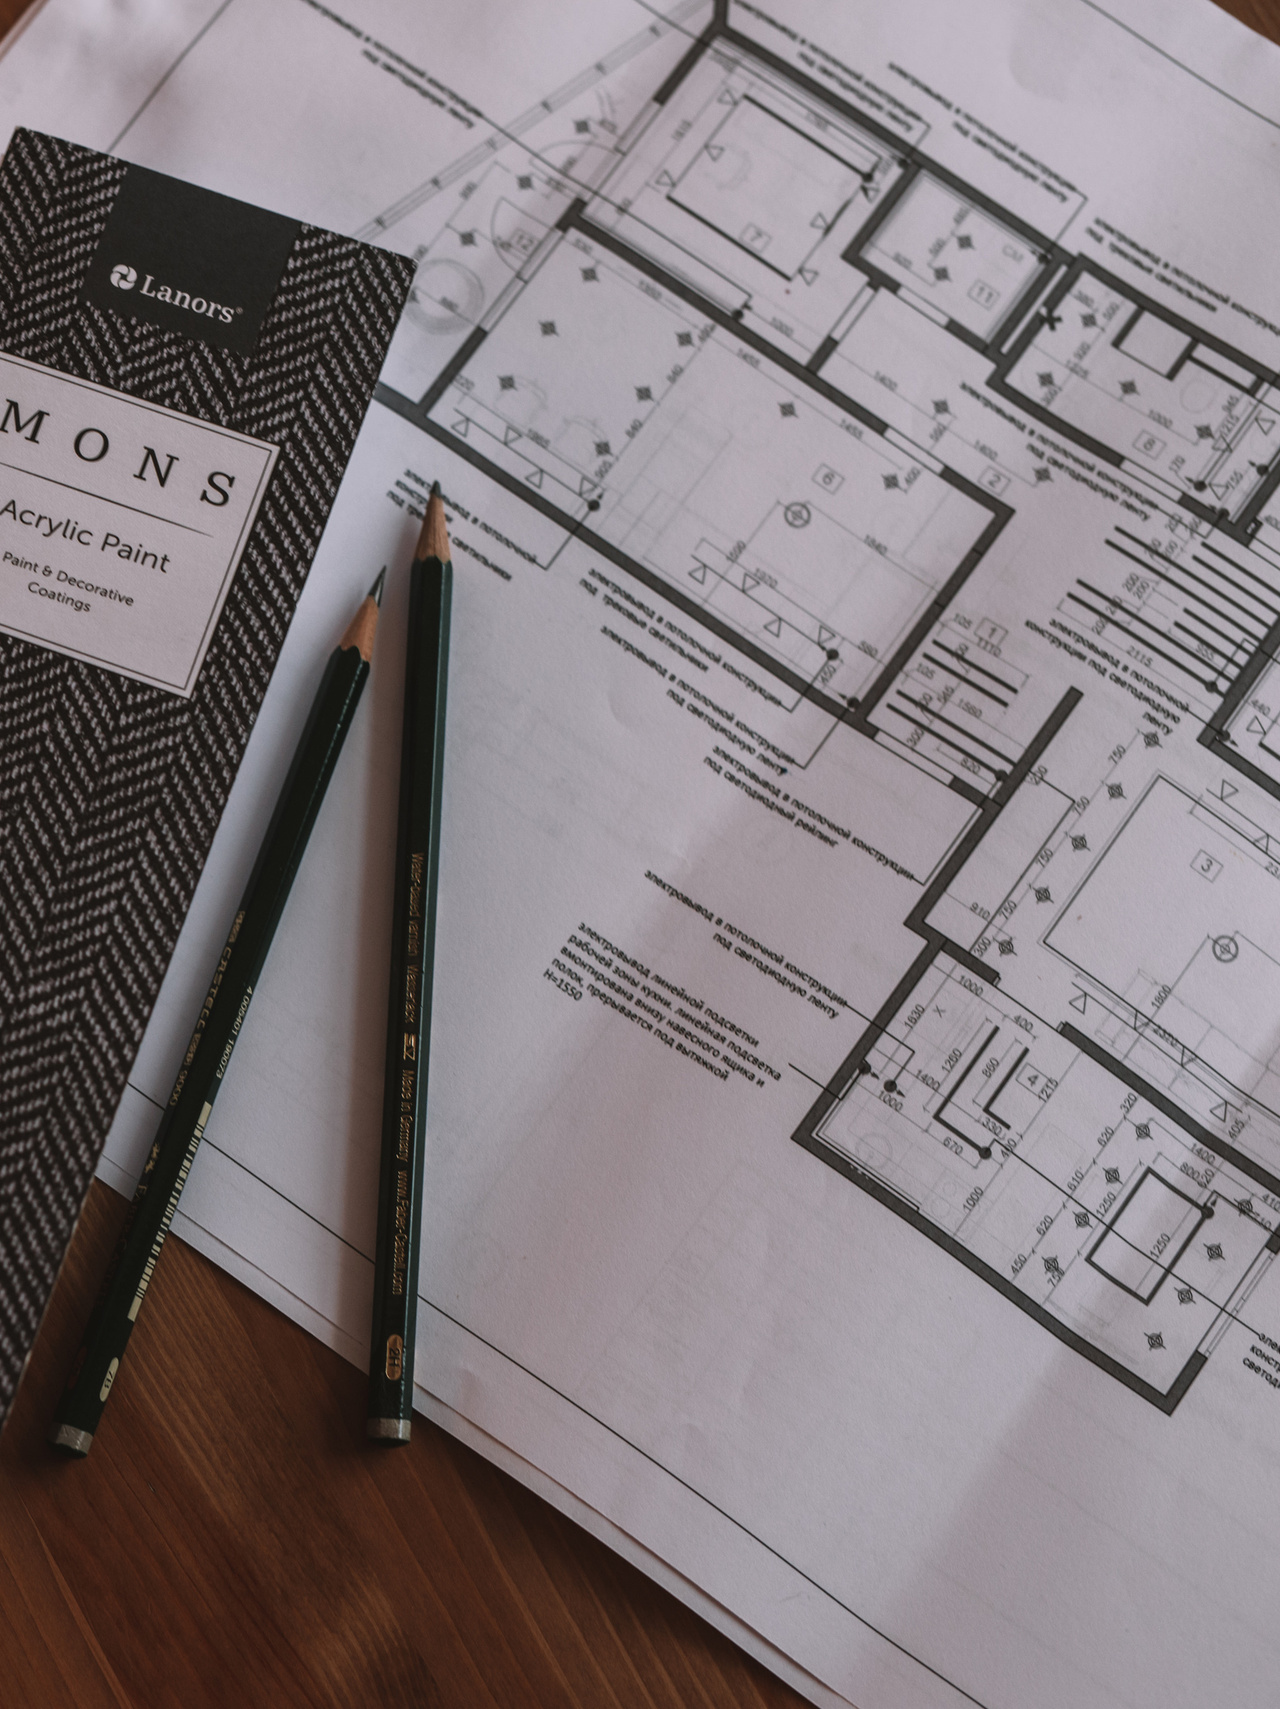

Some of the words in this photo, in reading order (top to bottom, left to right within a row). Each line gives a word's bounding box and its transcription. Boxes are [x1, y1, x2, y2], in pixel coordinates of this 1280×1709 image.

[820, 471, 835, 487] 6
[987, 473, 1001, 488] 2
[100, 532, 171, 574] Paint
[2, 551, 39, 574] Paint
[41, 565, 54, 578] &
[56, 570, 135, 607] Decorative
[27, 581, 92, 613] Coatings
[1127, 645, 1152, 667] 2115
[1087, 659, 1106, 676] под
[666, 688, 685, 706] под
[1121, 665, 1129, 673] в
[1130, 668, 1189, 712] потолочной
[961, 756, 979, 774] 820
[1109, 744, 1125, 764] 750
[703, 755, 722, 773] под
[722, 769, 795, 822] светодиодный
[795, 816, 837, 850] рейлинг
[711, 744, 782, 797] электровывод
[782, 793, 790, 801] в
[791, 796, 850, 840] потолочной
[851, 835, 913, 882] конструкции
[1072, 796, 1089, 817] 750
[1036, 847, 1053, 868] 750
[1201, 858, 1213, 873] 3
[970, 901, 990, 920] 910
[1000, 899, 1016, 920] 750
[643, 869, 714, 922] электровывод
[715, 917, 723, 925] в
[724, 920, 784, 965] потолочной
[783, 961, 847, 1008] конструкции
[973, 935, 991, 957] 300
[576, 922, 652, 978] электровывод
[651, 970, 704, 1011] линейной
[703, 1006, 759, 1049] подсветки
[712, 931, 732, 950] под
[733, 945, 807, 999] светодиодную
[807, 994, 838, 1020] ленту
[958, 974, 983, 997] 1000
[195, 945, 233, 1031] CASTELL
[244, 984, 256, 995] 4
[1151, 984, 1171, 1009] 1800
[229, 994, 253, 1036] 005401
[558, 946, 635, 1003] вмонтирована
[634, 997, 665, 1023] внизу
[665, 1017, 720, 1059] навесного
[720, 1053, 756, 1082] ящика
[755, 1078, 764, 1087] и
[567, 933, 612, 969] рабочей
[612, 965, 639, 988] зоны
[639, 983, 674, 1012] кухни.
[675, 1004, 726, 1044] линейная
[725, 1040, 781, 1082] подсветка
[904, 1003, 924, 1029] 1630
[550, 957, 587, 988] полок,
[585, 982, 653, 1033] прерывается
[653, 1027, 675, 1047] под
[675, 1040, 729, 1081] вытяжкой
[1013, 1013, 1033, 1032] 400
[941, 1047, 961, 1073] 1260
[982, 1057, 998, 1078] 860
[399, 1069, 415, 1100] Made
[915, 1069, 940, 1091] 1400
[1025, 1071, 1039, 1087] 4
[1038, 1077, 1058, 1103] 1215
[399, 1101, 413, 1112] in
[877, 1090, 902, 1112] 1000
[1120, 1092, 1137, 1114] 320
[981, 1117, 1001, 1136] 330
[1096, 1125, 1114, 1147] 620
[1227, 1118, 1245, 1141] 405
[395, 1114, 413, 1162] Germany
[942, 1136, 963, 1155] 670
[1190, 1143, 1215, 1165] 1400
[1180, 1162, 1199, 1180] 800
[963, 1186, 983, 1213] 1000
[1096, 1191, 1116, 1218] 1250
[1036, 1214, 1053, 1237] 620
[1149, 1232, 1170, 1259] 1250
[1009, 1253, 1027, 1276] 450
[387, 1347, 401, 1367] 2H
